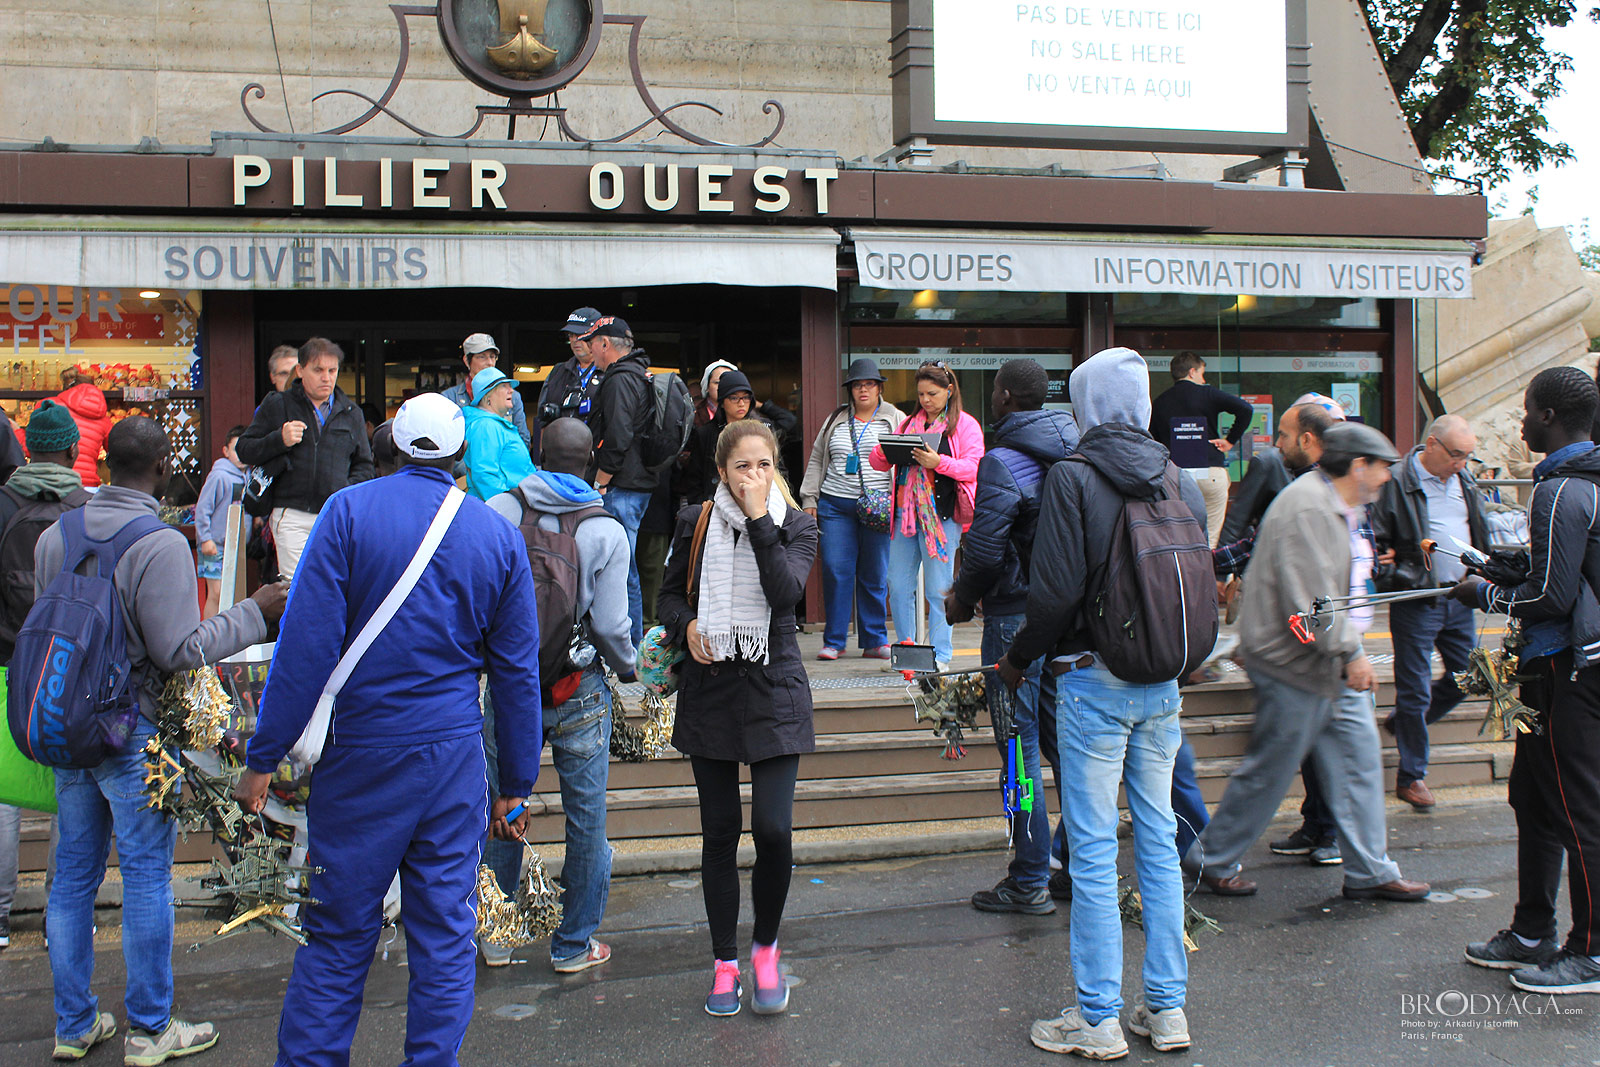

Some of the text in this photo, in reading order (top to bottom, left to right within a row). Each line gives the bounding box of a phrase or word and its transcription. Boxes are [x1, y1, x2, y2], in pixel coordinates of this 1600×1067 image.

[1016, 4, 1201, 32] PAS DE VENTE ICI
[1031, 39, 1186, 65] NO SALE HERE
[1027, 73, 1191, 102] NO VENTA AQUI
[232, 154, 840, 215] PILIER OUEST
[163, 245, 428, 283] SOUVENIRS
[865, 252, 1013, 283] GROUPES
[1094, 256, 1466, 293] INFORMATION VISITEURS
[100, 322, 137, 330] BEST OF
[879, 357, 921, 365] COMPTOIR
[1307, 361, 1355, 369] INFORMATION
